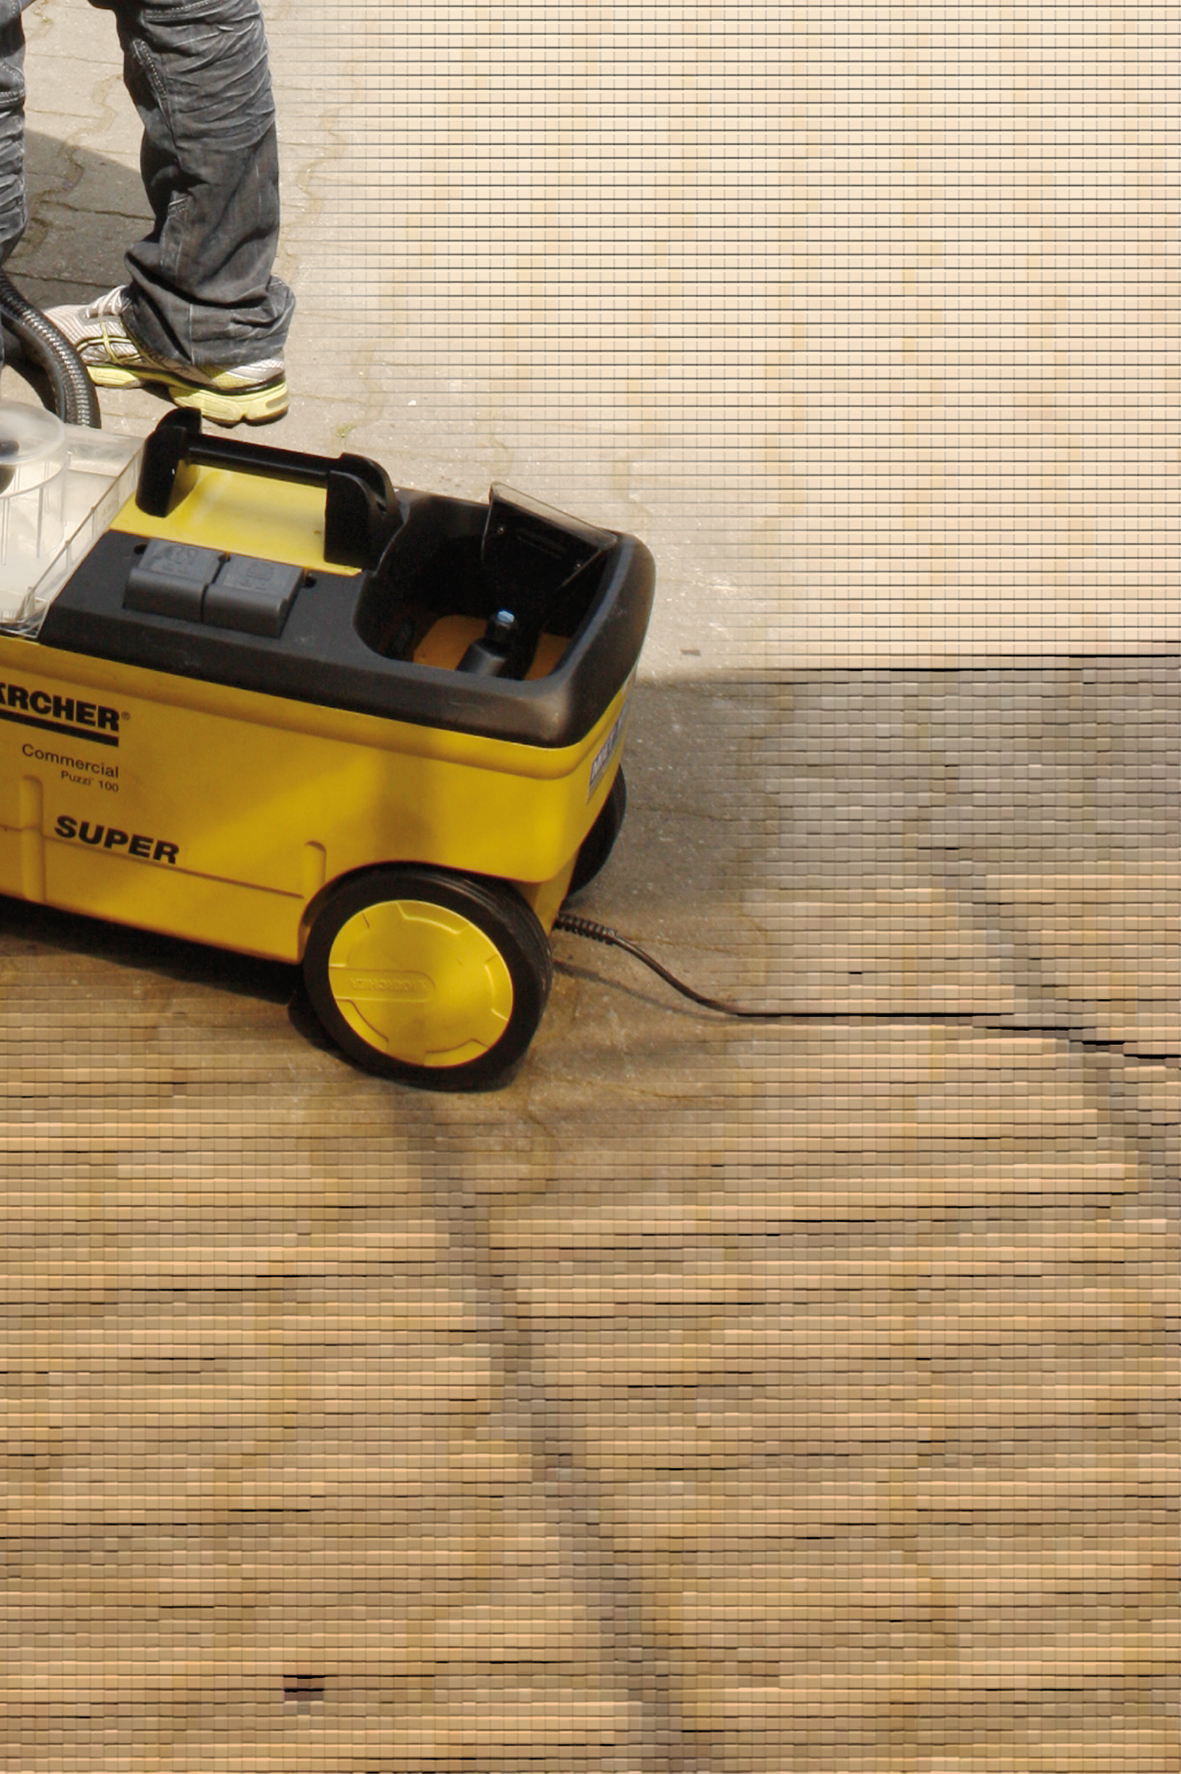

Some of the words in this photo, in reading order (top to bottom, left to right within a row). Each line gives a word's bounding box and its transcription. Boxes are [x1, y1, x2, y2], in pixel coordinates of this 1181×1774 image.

[22, 743, 119, 779] Commercial
[99, 780, 119, 793] 100
[54, 815, 180, 865] SUPER
